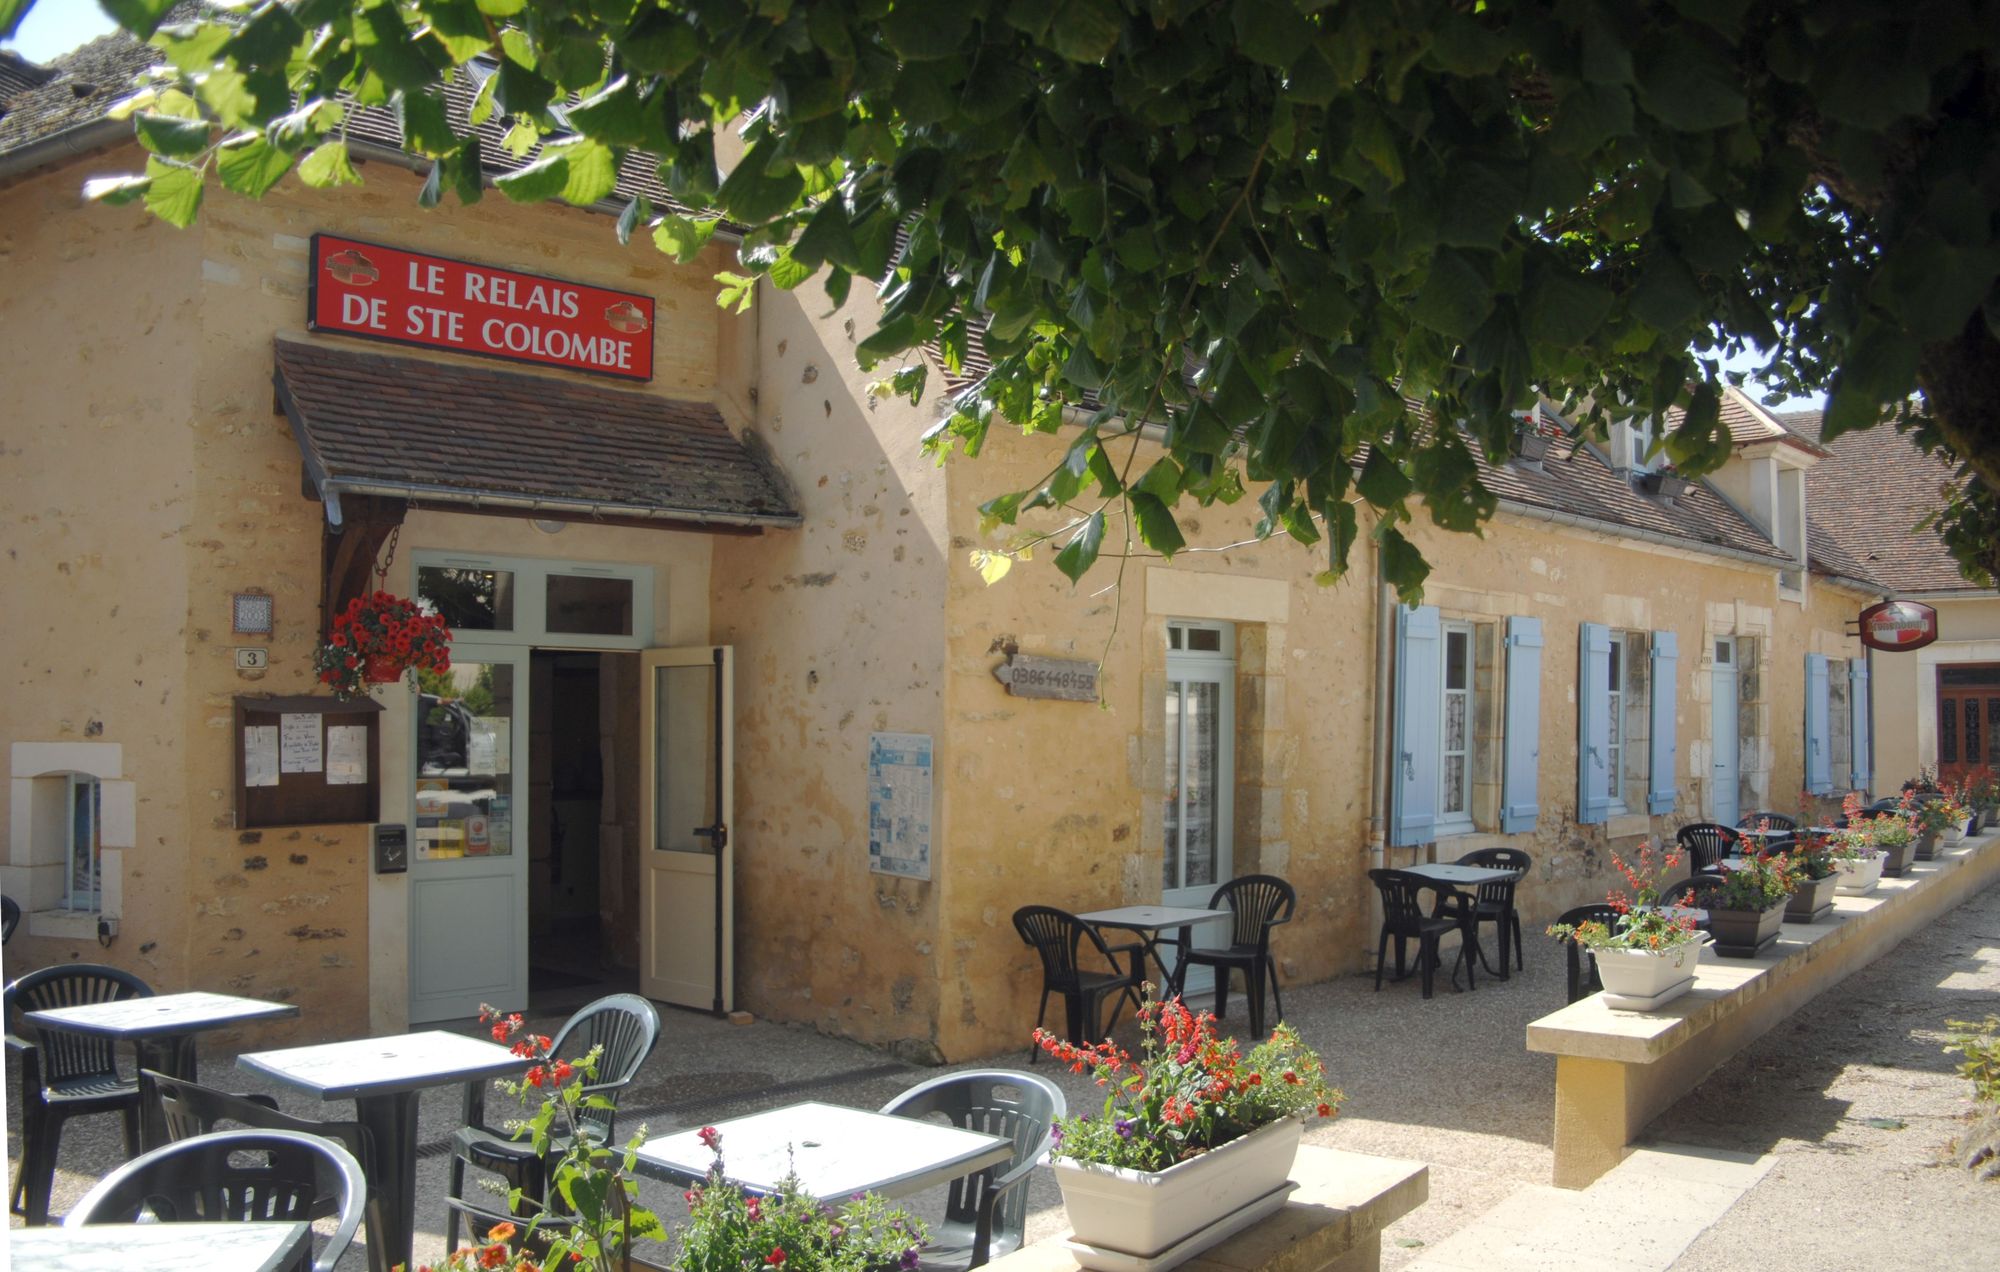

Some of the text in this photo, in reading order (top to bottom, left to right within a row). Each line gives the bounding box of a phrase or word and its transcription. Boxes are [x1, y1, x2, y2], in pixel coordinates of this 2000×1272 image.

[408, 261, 445, 296] LE
[464, 272, 579, 319] RELAIS
[342, 293, 632, 370] DE STE COLOMBE
[247, 652, 257, 666] 3
[1012, 667, 1094, 690] 0386448455
